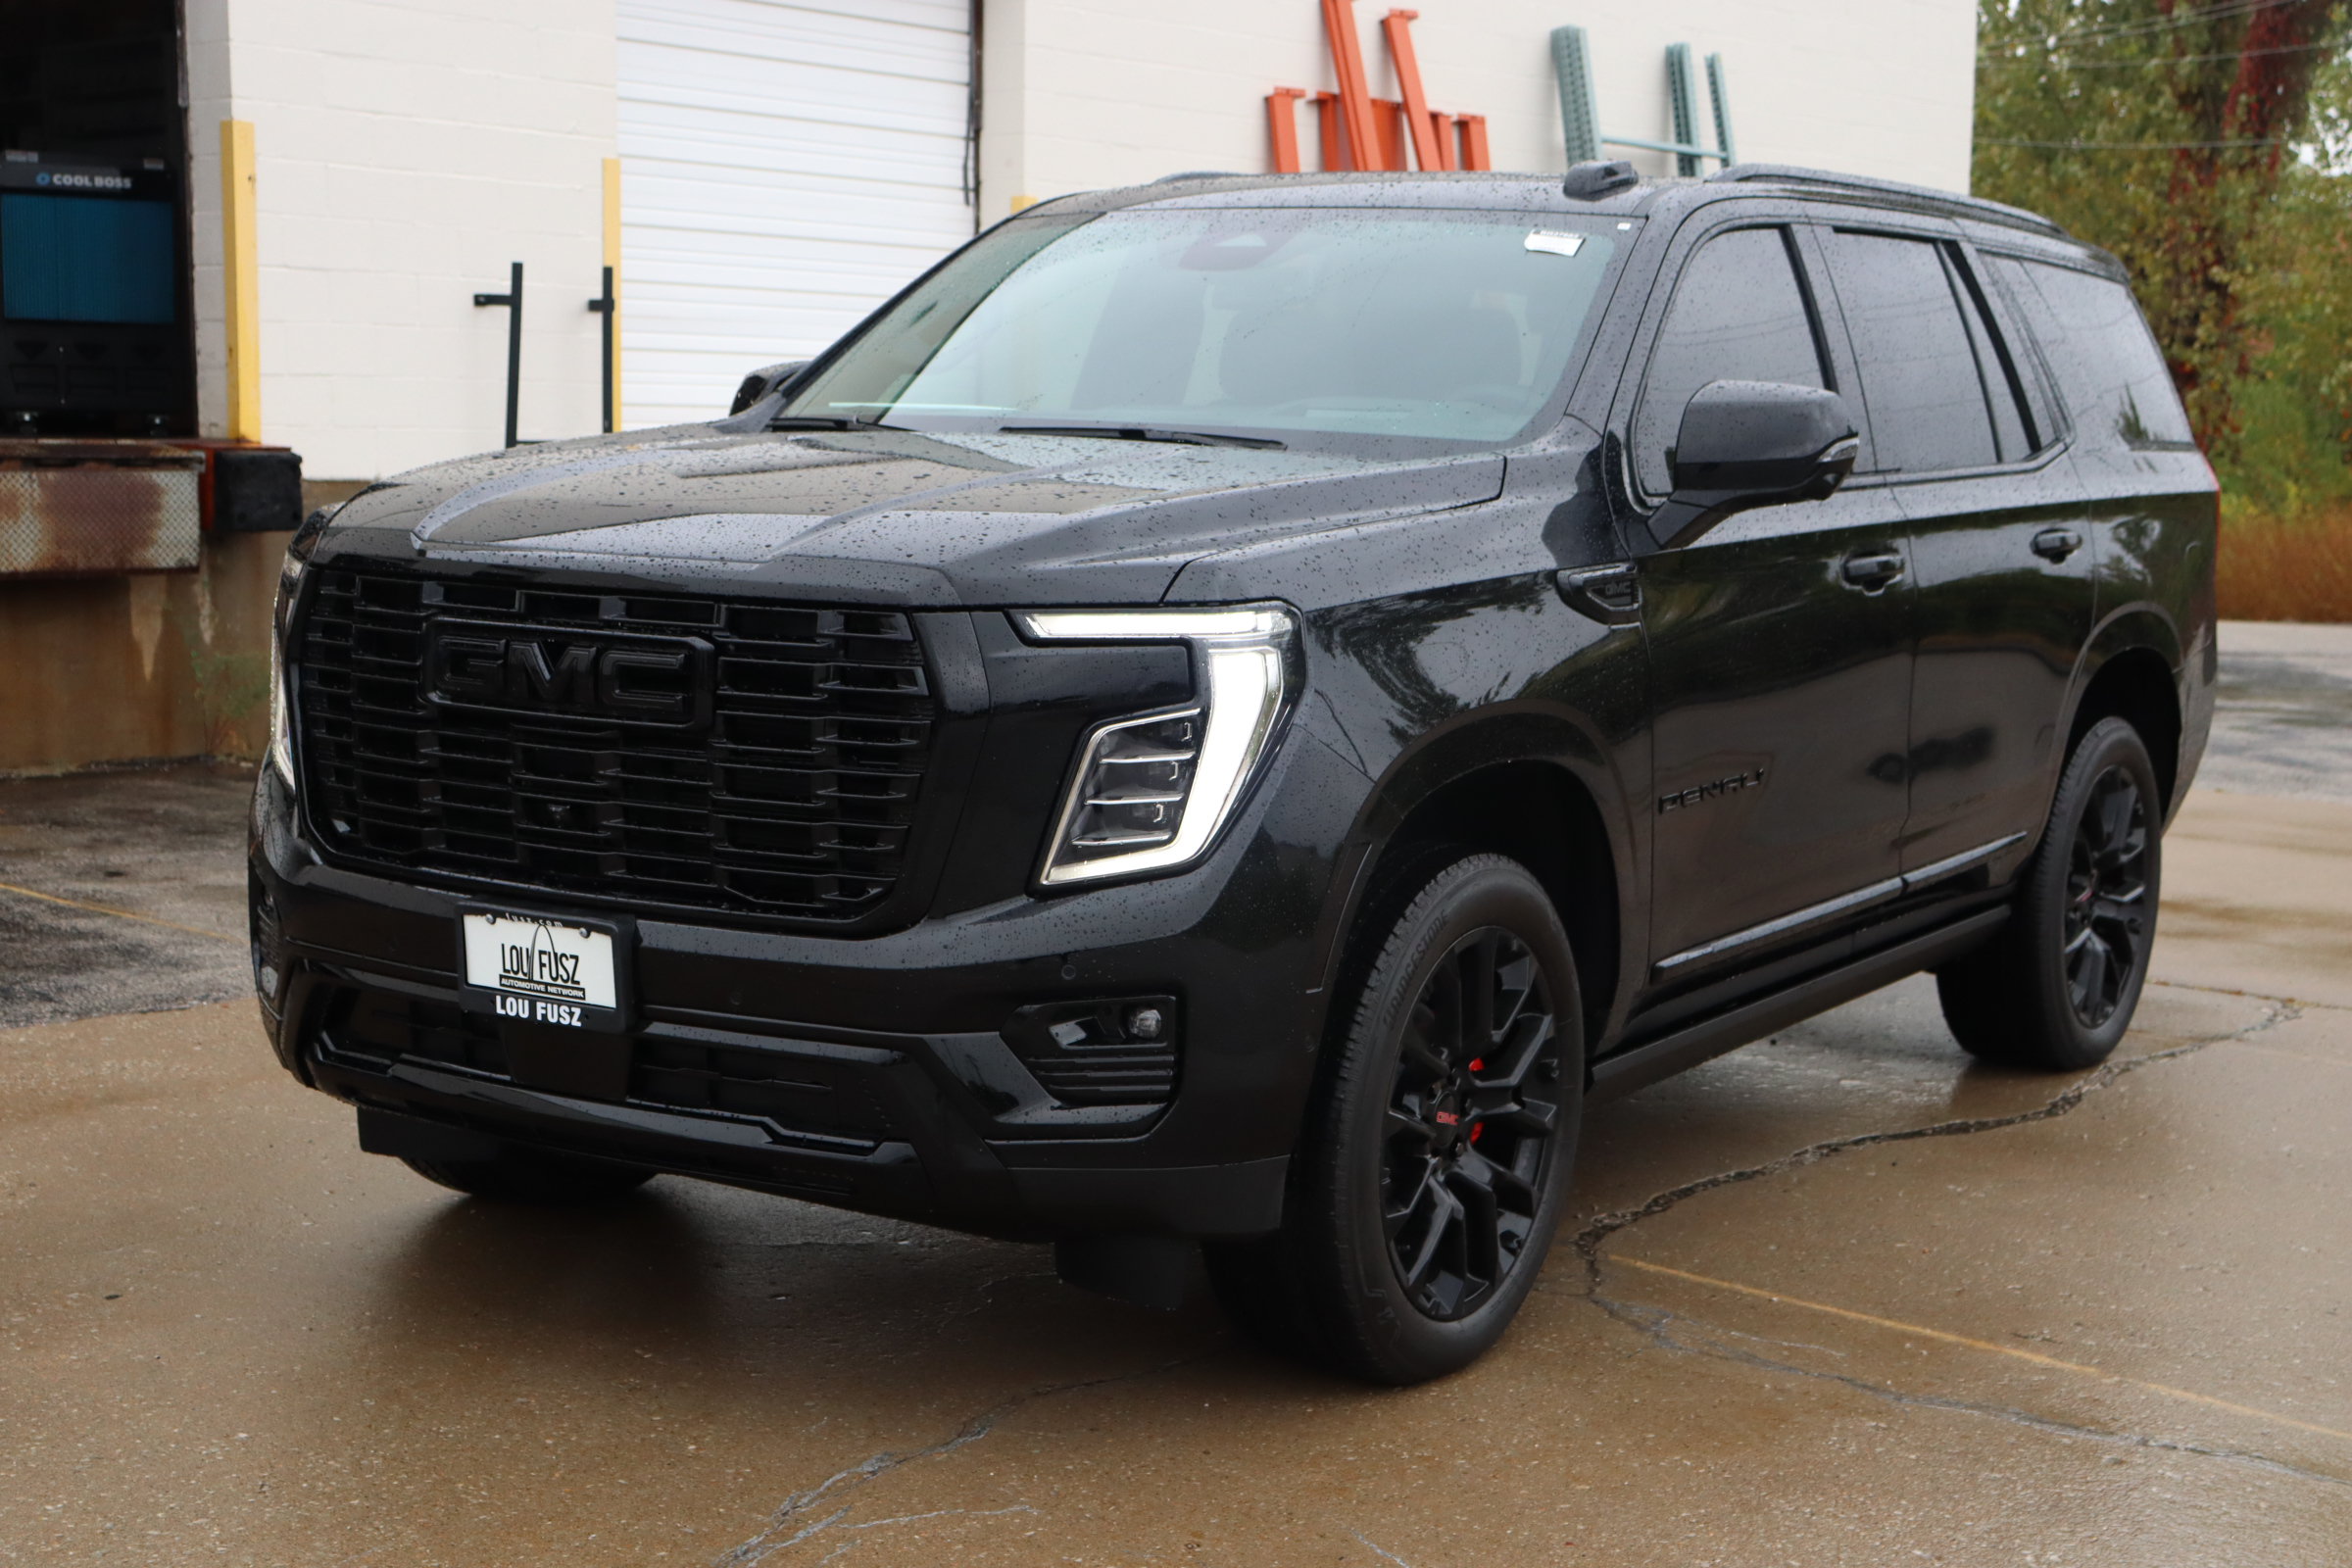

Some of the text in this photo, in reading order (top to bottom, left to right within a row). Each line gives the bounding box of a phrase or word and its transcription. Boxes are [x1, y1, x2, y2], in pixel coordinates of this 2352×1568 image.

[1605, 580, 1631, 596] GMC
[437, 634, 686, 712] GMC
[501, 943, 581, 986] LOU FUSZ
[501, 978, 585, 998] AUTOMOTIVE NETWORK
[496, 995, 582, 1027] LOU FUSZ
